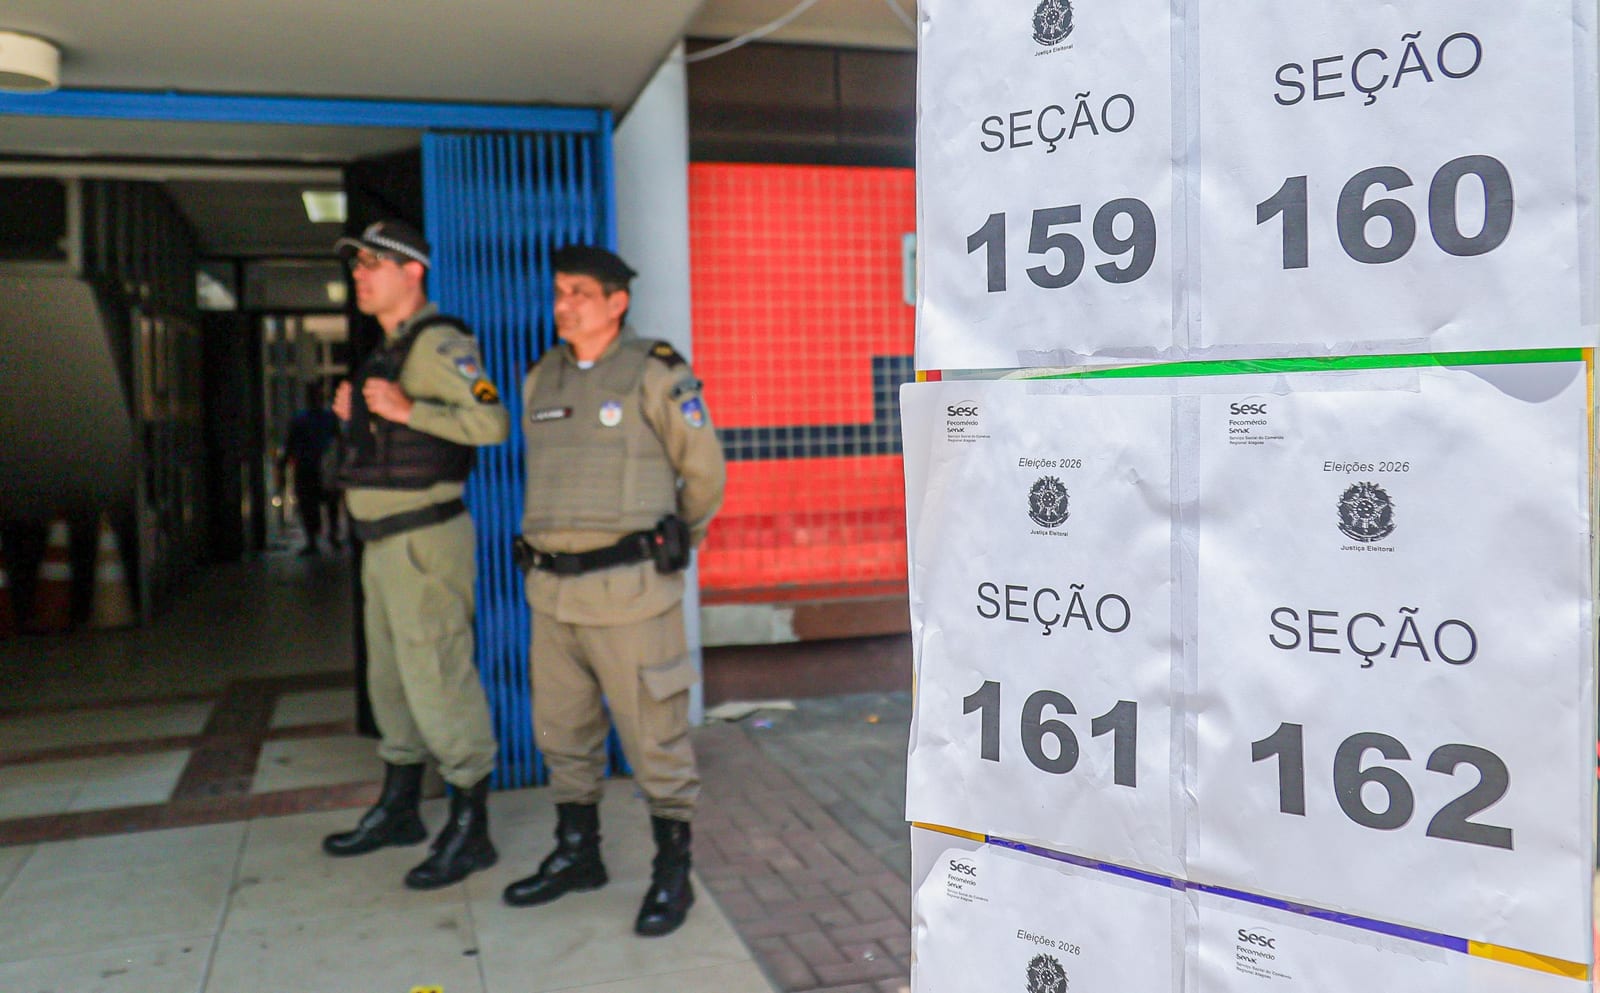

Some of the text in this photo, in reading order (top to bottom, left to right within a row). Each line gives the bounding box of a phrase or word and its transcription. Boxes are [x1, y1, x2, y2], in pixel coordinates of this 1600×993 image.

[1273, 30, 1483, 106] SEÇÃO
[980, 91, 1135, 154] SEÇÃO
[1256, 154, 1515, 271] 160
[966, 197, 1157, 294] 159
[947, 405, 978, 417] Sesc
[1230, 402, 1267, 415] Sesc
[1018, 457, 1082, 469] Eleições 2026
[1323, 461, 1410, 474] Eleições 2026
[1367, 545, 1395, 553] Eleitoral
[976, 581, 1132, 636] SEÇÃO
[1269, 606, 1478, 669] SEÇÃO
[962, 679, 1138, 789] 161
[1251, 721, 1515, 851] 162
[950, 859, 977, 877] Sesc
[1016, 929, 1081, 956] Eleições 2026
[1238, 928, 1276, 950] Sesc
